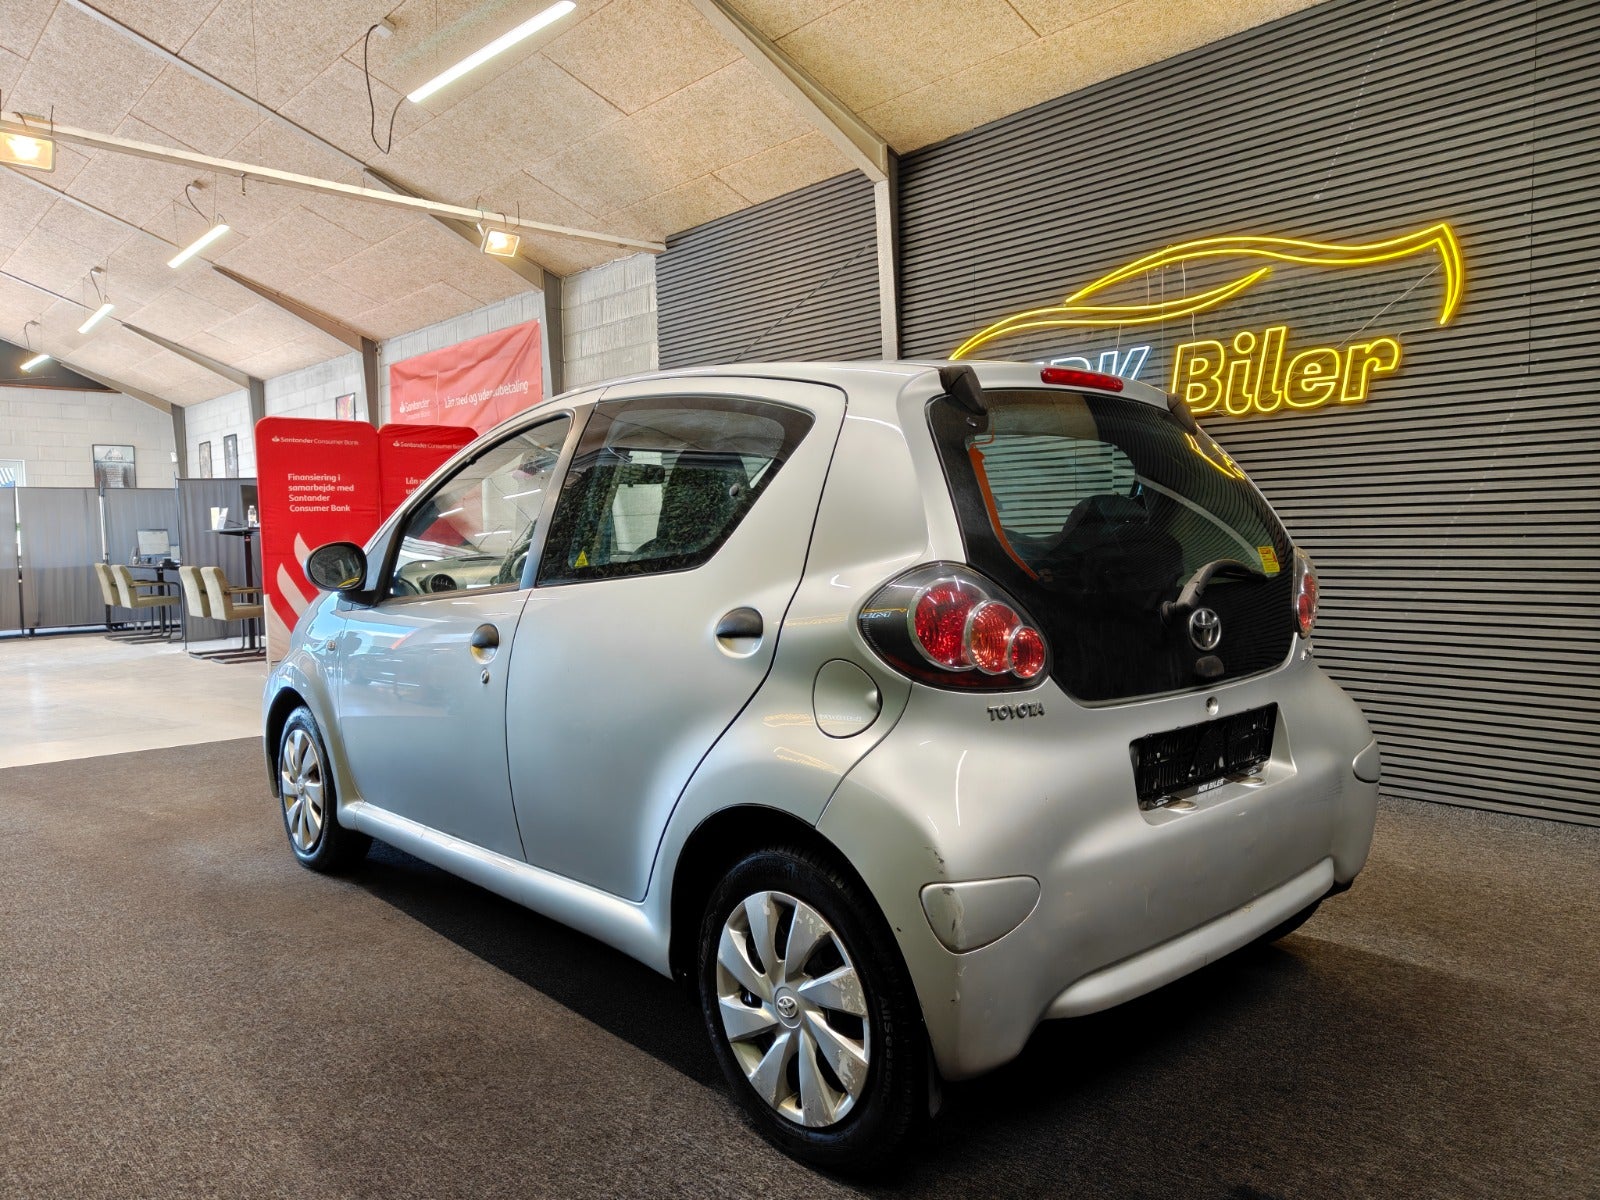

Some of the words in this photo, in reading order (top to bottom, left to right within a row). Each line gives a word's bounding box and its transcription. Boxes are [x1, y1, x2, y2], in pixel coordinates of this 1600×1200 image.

[1172, 325, 1401, 415] Biler
[400, 441, 427, 449] Santander
[288, 473, 336, 482] Finansiering
[405, 477, 418, 485] Lån
[288, 484, 335, 492] samarbejde
[336, 484, 354, 492] med
[288, 494, 330, 502] Santander
[289, 504, 329, 512] Consumer
[331, 504, 351, 512] Bank
[987, 702, 1045, 721] TOYOTA
